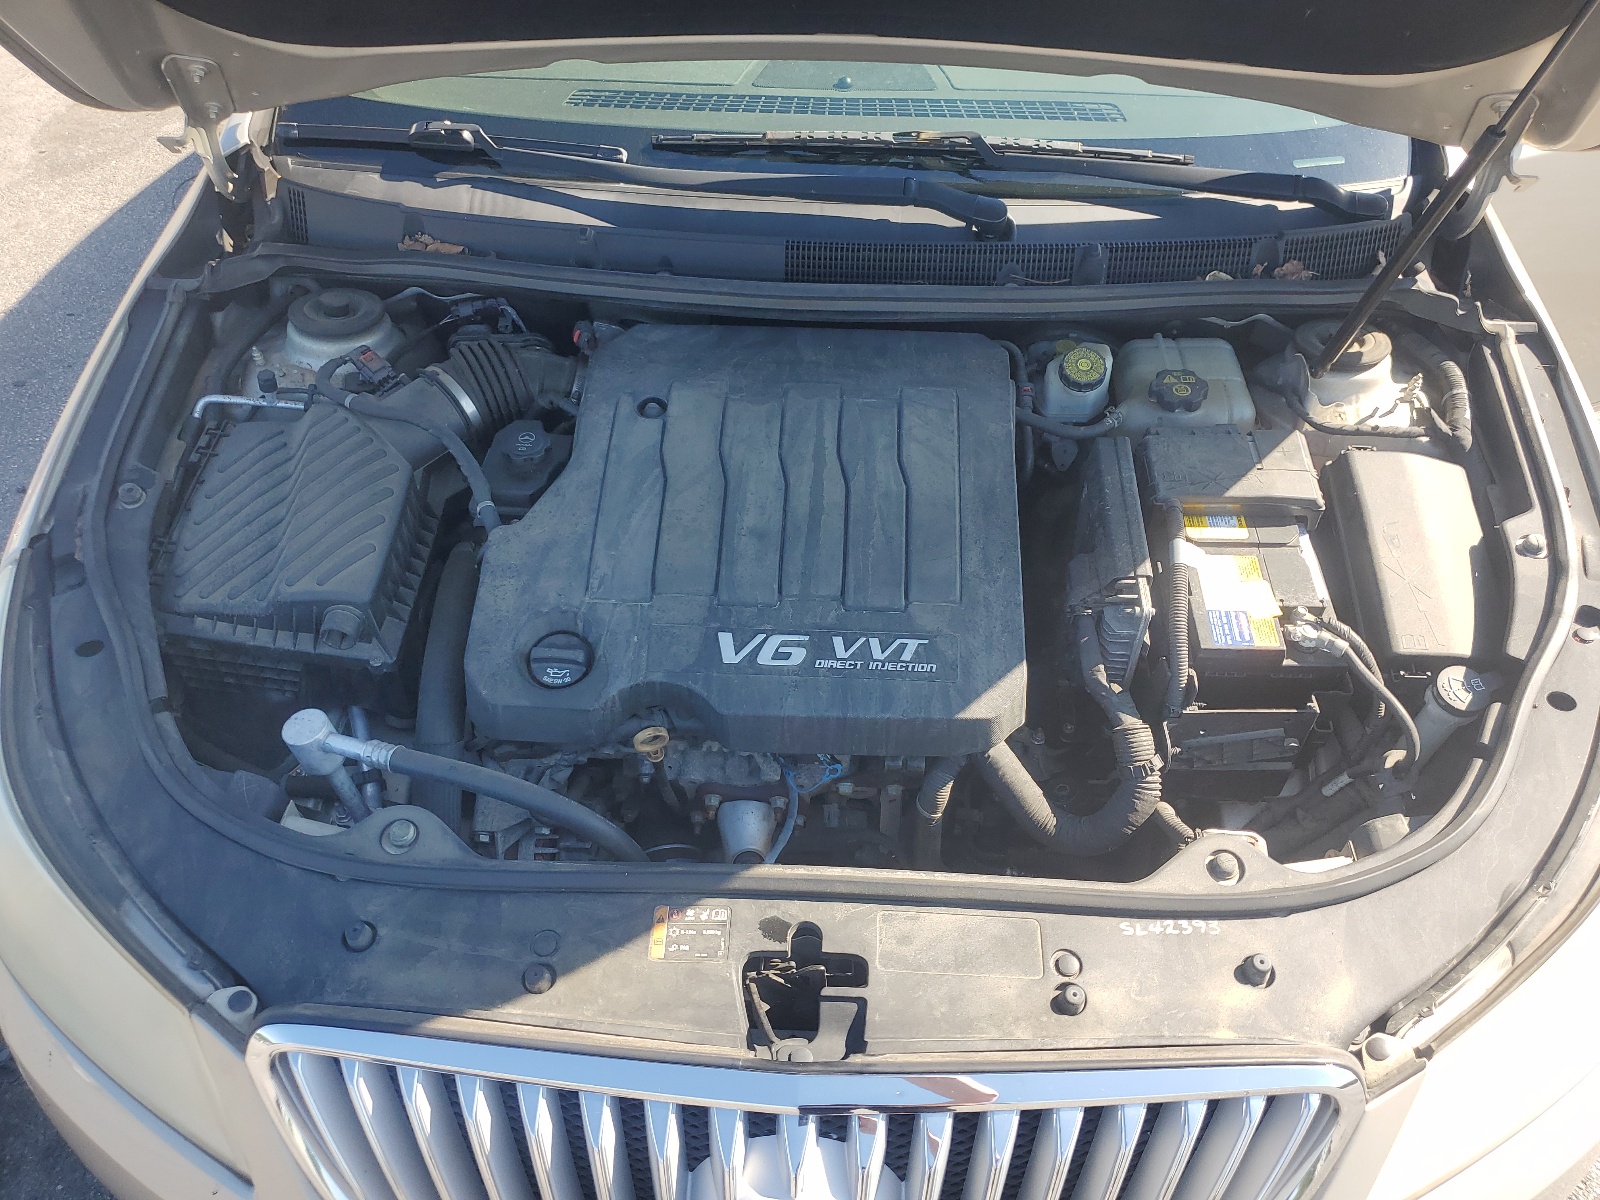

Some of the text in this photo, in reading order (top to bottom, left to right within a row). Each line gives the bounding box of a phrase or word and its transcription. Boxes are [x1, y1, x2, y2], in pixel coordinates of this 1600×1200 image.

[717, 631, 929, 666] V6 VVT
[814, 659, 937, 673] DIRECT INJECTION
[1119, 919, 1220, 936] SL42393
